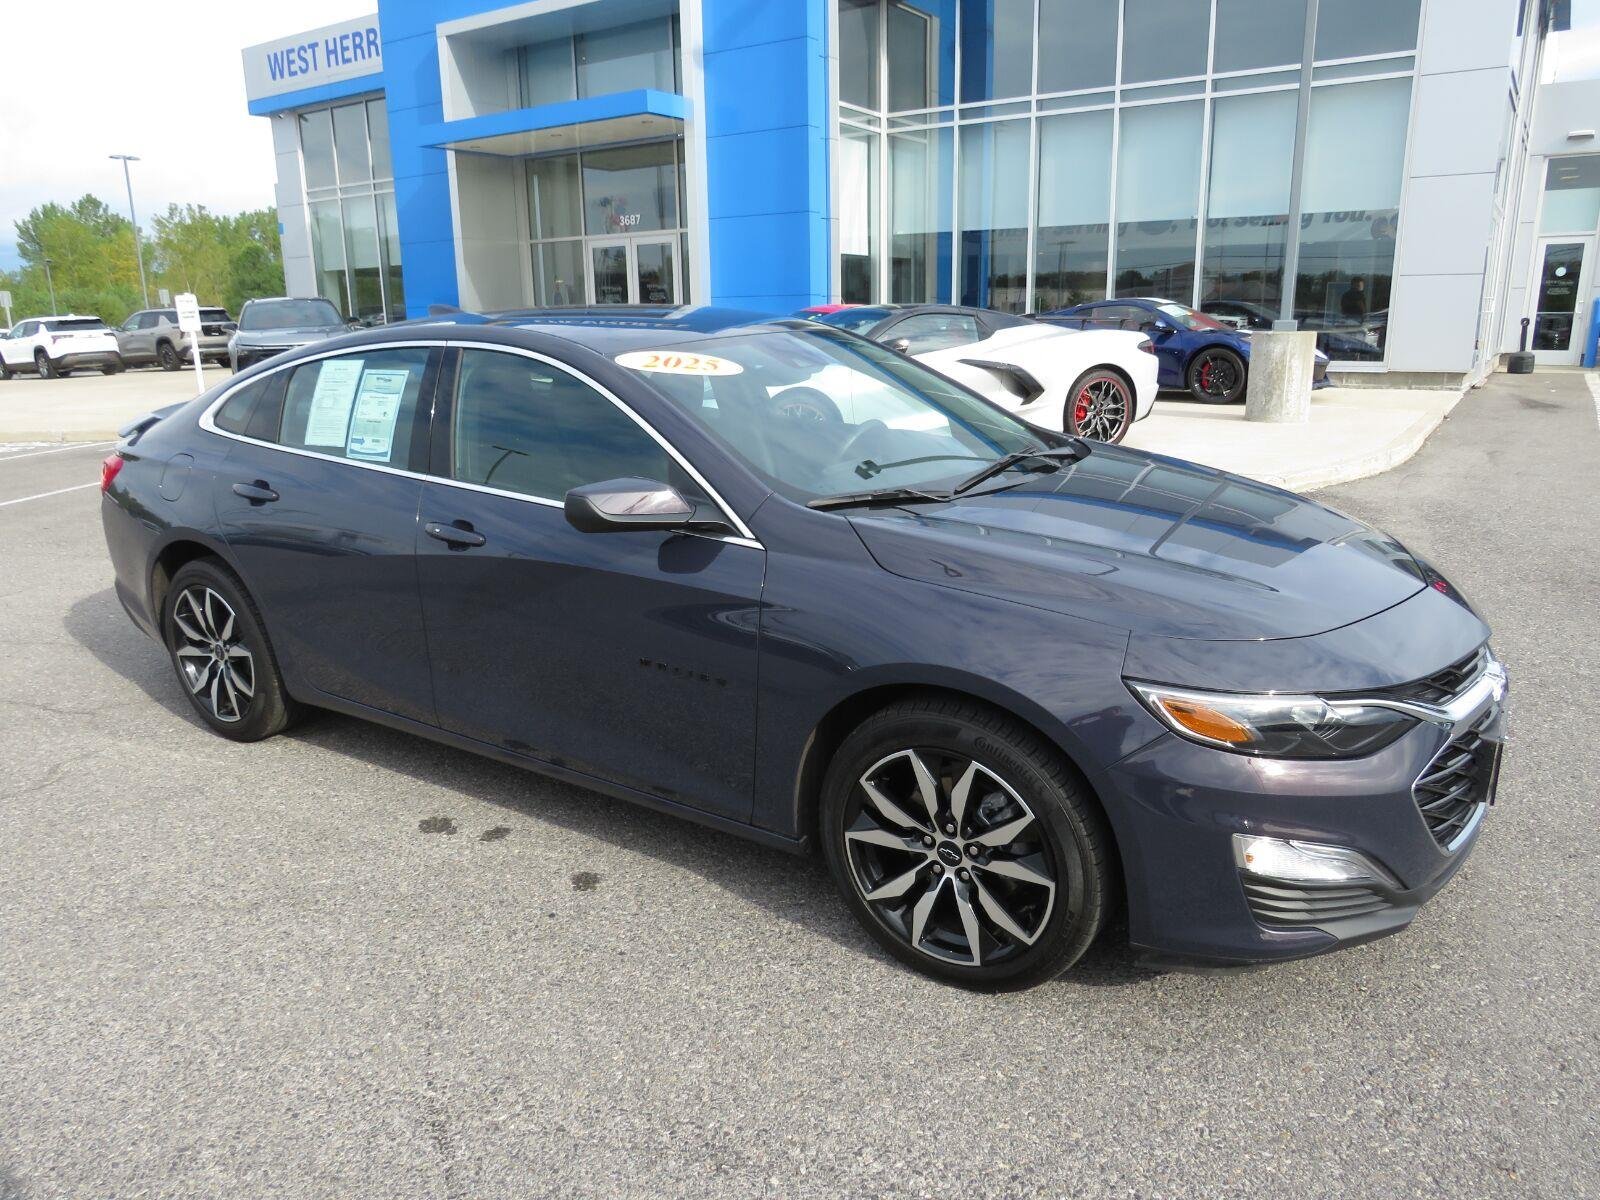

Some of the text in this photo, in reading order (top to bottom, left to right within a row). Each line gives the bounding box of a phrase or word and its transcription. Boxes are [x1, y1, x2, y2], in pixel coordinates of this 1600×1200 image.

[266, 28, 381, 81] WEST HERR
[619, 214, 641, 226] 3687
[641, 354, 721, 371] 2025
